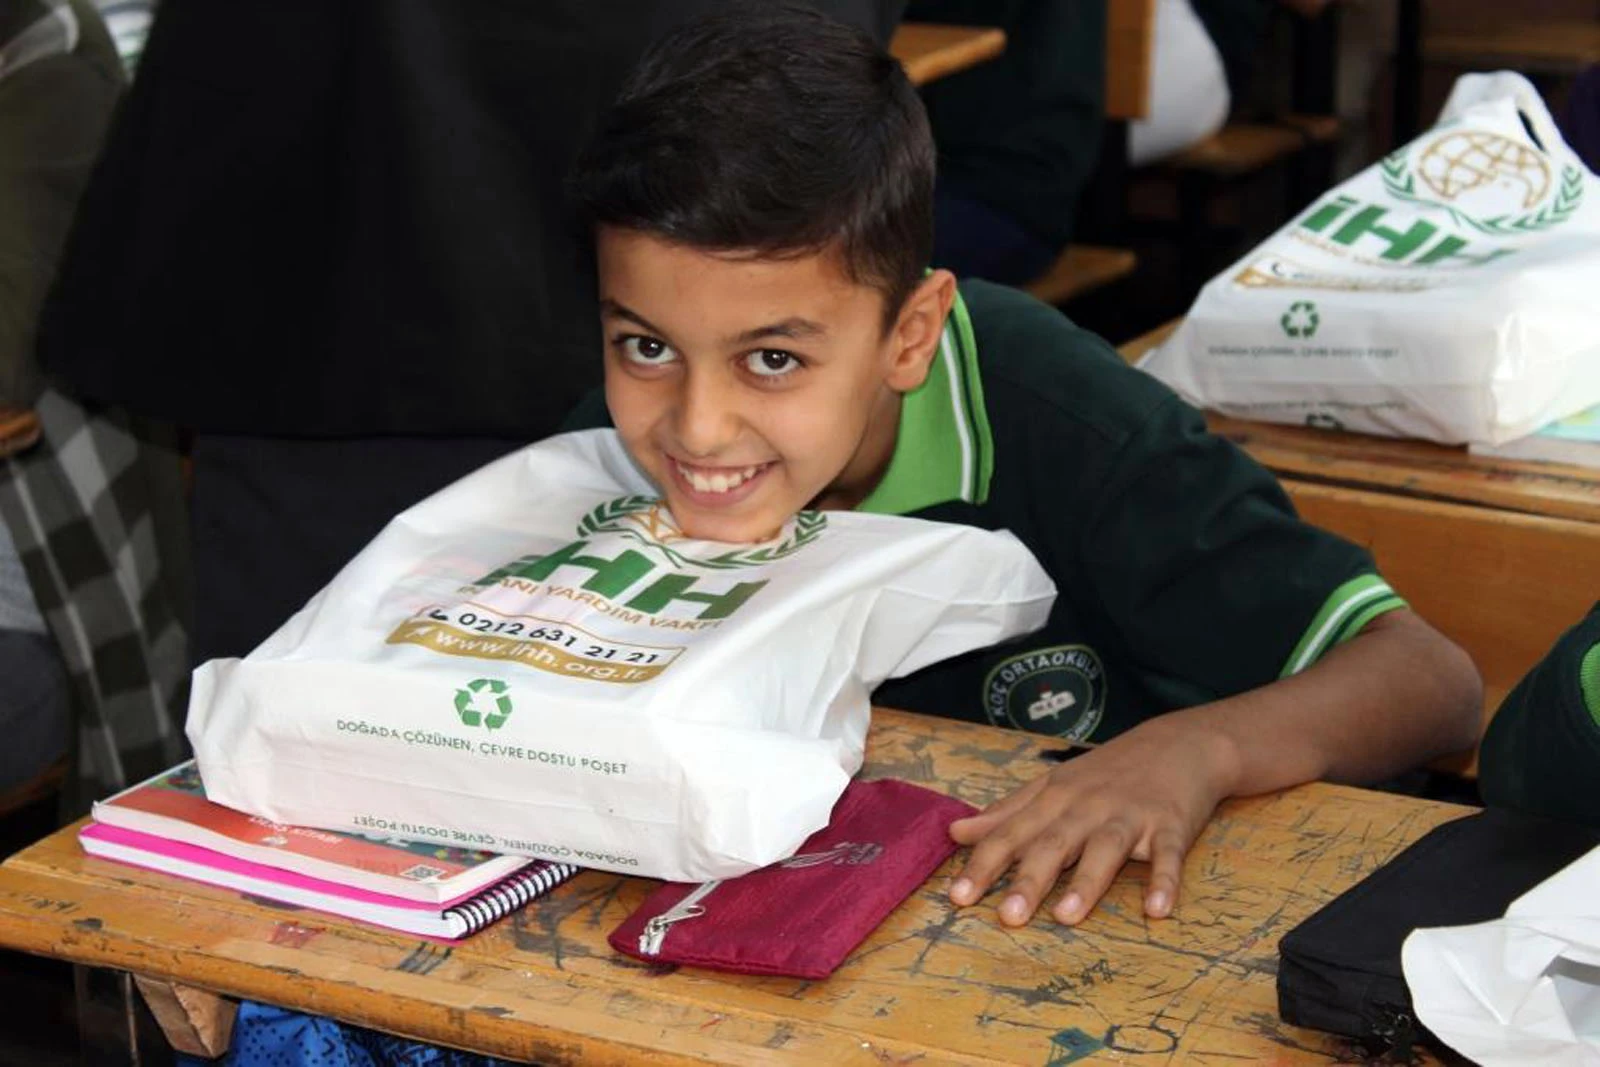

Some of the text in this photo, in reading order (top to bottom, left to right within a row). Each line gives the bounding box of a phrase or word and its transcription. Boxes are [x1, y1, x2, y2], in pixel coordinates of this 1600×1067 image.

[546, 585, 642, 625] YARDIM
[458, 612, 659, 663] 0212 631 21 21
[336, 719, 627, 775] DOĞADA ÇÖZÜNEN, ÇEVRE DOSTU POŞET
